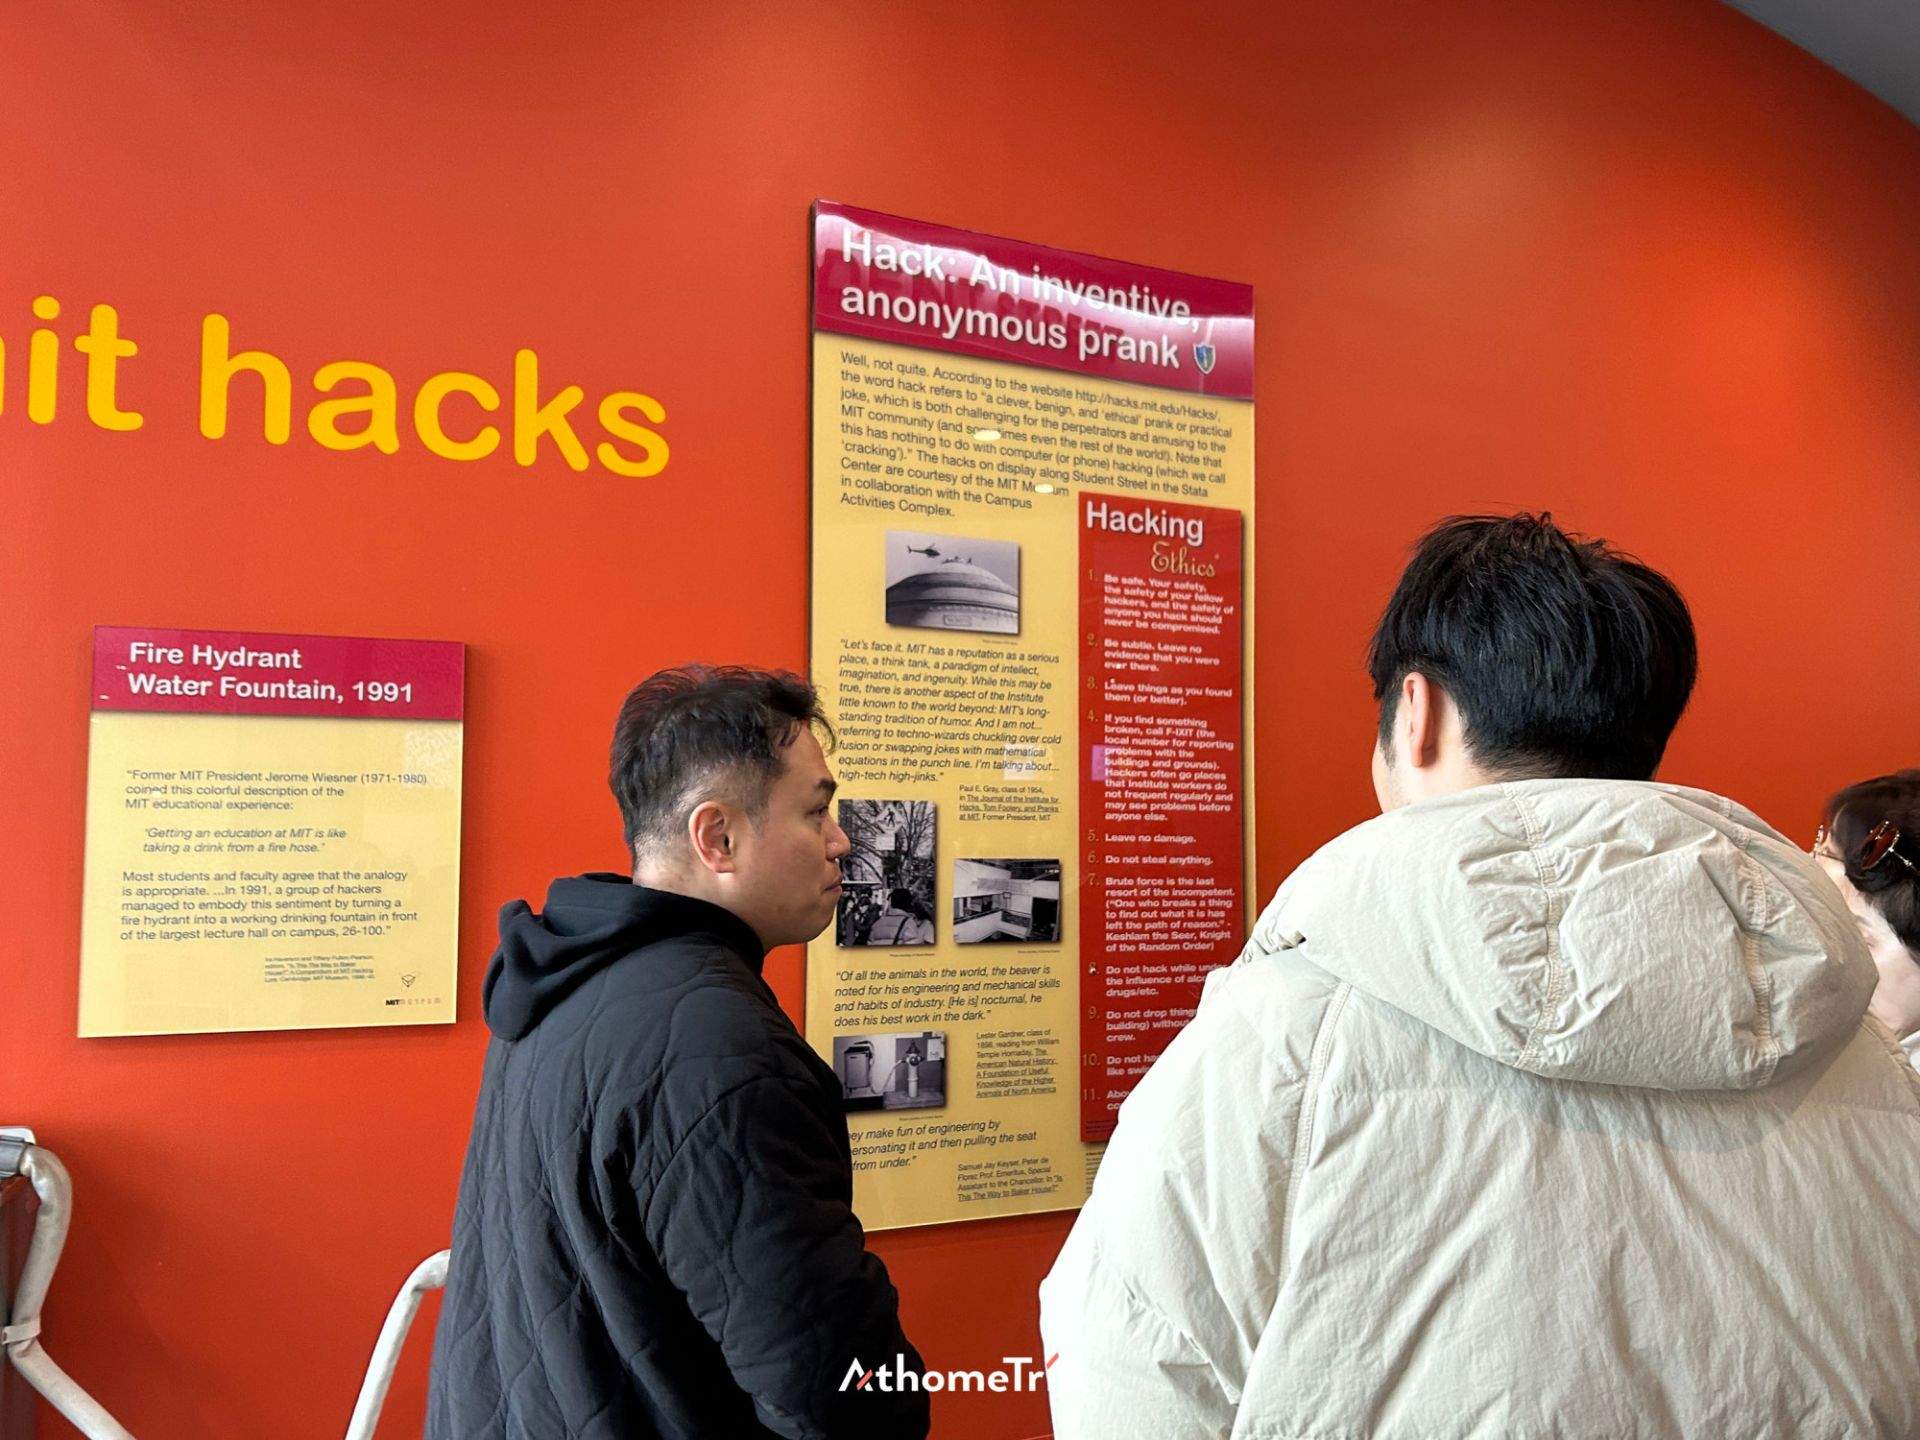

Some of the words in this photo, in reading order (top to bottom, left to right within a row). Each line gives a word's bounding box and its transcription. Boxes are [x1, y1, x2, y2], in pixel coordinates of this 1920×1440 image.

[842, 228, 956, 282] Hack:
[970, 256, 1020, 293] An
[1031, 264, 1200, 332] inventive,
[841, 286, 1067, 349] anonymous
[1079, 328, 1179, 368] prank
[841, 351, 869, 368] Well,
[874, 360, 893, 371] not
[897, 364, 929, 377] quite.
[933, 367, 992, 389] According
[995, 377, 1007, 389] to
[1009, 379, 1028, 392] the
[1030, 385, 1073, 399] website
[0, 296, 144, 431] it
[200, 313, 670, 478] hacks
[841, 370, 861, 383] the
[864, 376, 894, 389] word
[897, 378, 926, 393] hack
[929, 385, 963, 399] refers
[966, 389, 978, 401] to
[996, 395, 1032, 410] clever,
[1035, 399, 1075, 416] benign,
[1078, 408, 1099, 419] and
[1144, 418, 1174, 430] prank
[1176, 422, 1187, 432] or
[1189, 424, 1232, 438] practical
[840, 492, 896, 510] Activities
[898, 499, 955, 517] Complex.
[1086, 501, 1203, 546] Hacking
[130, 642, 184, 664] Fire
[193, 644, 302, 671] Hydrant
[871, 641, 893, 652] face
[894, 644, 902, 652] it.
[906, 643, 927, 654] MIT
[928, 646, 945, 656] has
[947, 648, 954, 657] a
[956, 649, 1004, 659] reputation
[1006, 652, 1017, 660] as
[1019, 653, 1025, 661] a
[1027, 654, 1060, 664] serious
[128, 673, 213, 696] Water
[220, 676, 343, 703] Fountain,
[353, 682, 411, 702] 1991
[180, 770, 203, 780] MIT
[206, 770, 262, 781] President
[265, 772, 309, 782] Jerome
[312, 772, 358, 783] Wiesner
[361, 773, 427, 785] (1971-1980)
[838, 769, 887, 782] high-tech
[171, 785, 193, 795] this
[196, 785, 241, 796] colorful
[243, 786, 308, 798] description
[311, 786, 323, 796] of
[326, 787, 345, 797] the
[126, 798, 150, 808] MIT
[152, 799, 223, 809] educational
[226, 801, 294, 811] experience:
[195, 830, 211, 838] an
[214, 829, 272, 838] education
[274, 829, 287, 838] at
[289, 828, 313, 838] MIT
[314, 830, 325, 839] is
[327, 829, 347, 839] like
[1105, 833, 1136, 842] Leave
[143, 843, 180, 855] taking
[183, 844, 191, 852] a
[194, 842, 223, 852] drink
[227, 842, 255, 852] from
[257, 844, 265, 852] a
[268, 842, 287, 852] fire
[1105, 855, 1120, 864] Do
[1122, 855, 1139, 864] not
[1142, 855, 1167, 864] steal
[123, 871, 154, 882] Most
[158, 872, 210, 881] students
[213, 871, 236, 881] and
[240, 871, 279, 883] faculty
[281, 872, 315, 883] agree
[317, 871, 340, 880] that
[342, 871, 361, 880] the
[364, 870, 408, 882] analogy
[122, 888, 132, 896] is
[136, 887, 209, 898] appropriate.
[240, 885, 271, 896] 1991,
[275, 887, 283, 895] a
[285, 886, 320, 897] group
[322, 884, 334, 894] of
[337, 884, 382, 894] hackers
[122, 901, 179, 913] managed
[183, 901, 195, 910] to
[198, 899, 248, 912] embody
[251, 900, 272, 909] this
[275, 899, 332, 909] sentiment
[335, 899, 349, 910] by
[352, 899, 392, 910] turning
[394, 900, 402, 908] a
[121, 916, 140, 926] fire
[144, 915, 190, 927] hydrant
[194, 915, 217, 925] into
[219, 916, 227, 924] a
[230, 914, 277, 925] working
[280, 914, 327, 925] drinking
[330, 912, 376, 922] fountain
[379, 911, 389, 921] in
[391, 911, 418, 921] front
[120, 930, 133, 940] of
[136, 930, 157, 940] the
[160, 930, 200, 942] largest
[204, 929, 245, 939] lecture
[248, 928, 268, 938] hall
[271, 929, 286, 937] on
[289, 928, 339, 938] campus,
[855, 971, 868, 981] all
[870, 971, 886, 980] the
[888, 968, 927, 980] animals
[929, 970, 939, 978] in
[941, 968, 957, 978] the
[959, 966, 989, 977] world,
[991, 966, 1007, 976] the
[1009, 966, 1042, 976] beaver
[1042, 966, 1050, 975] is
[834, 1017, 860, 1027] does
[862, 1015, 878, 1025] his
[880, 1015, 903, 1025] best
[905, 1013, 930, 1023] work
[932, 1012, 942, 1022] in
[944, 1011, 960, 1022] the
[852, 1161, 876, 1171] from
